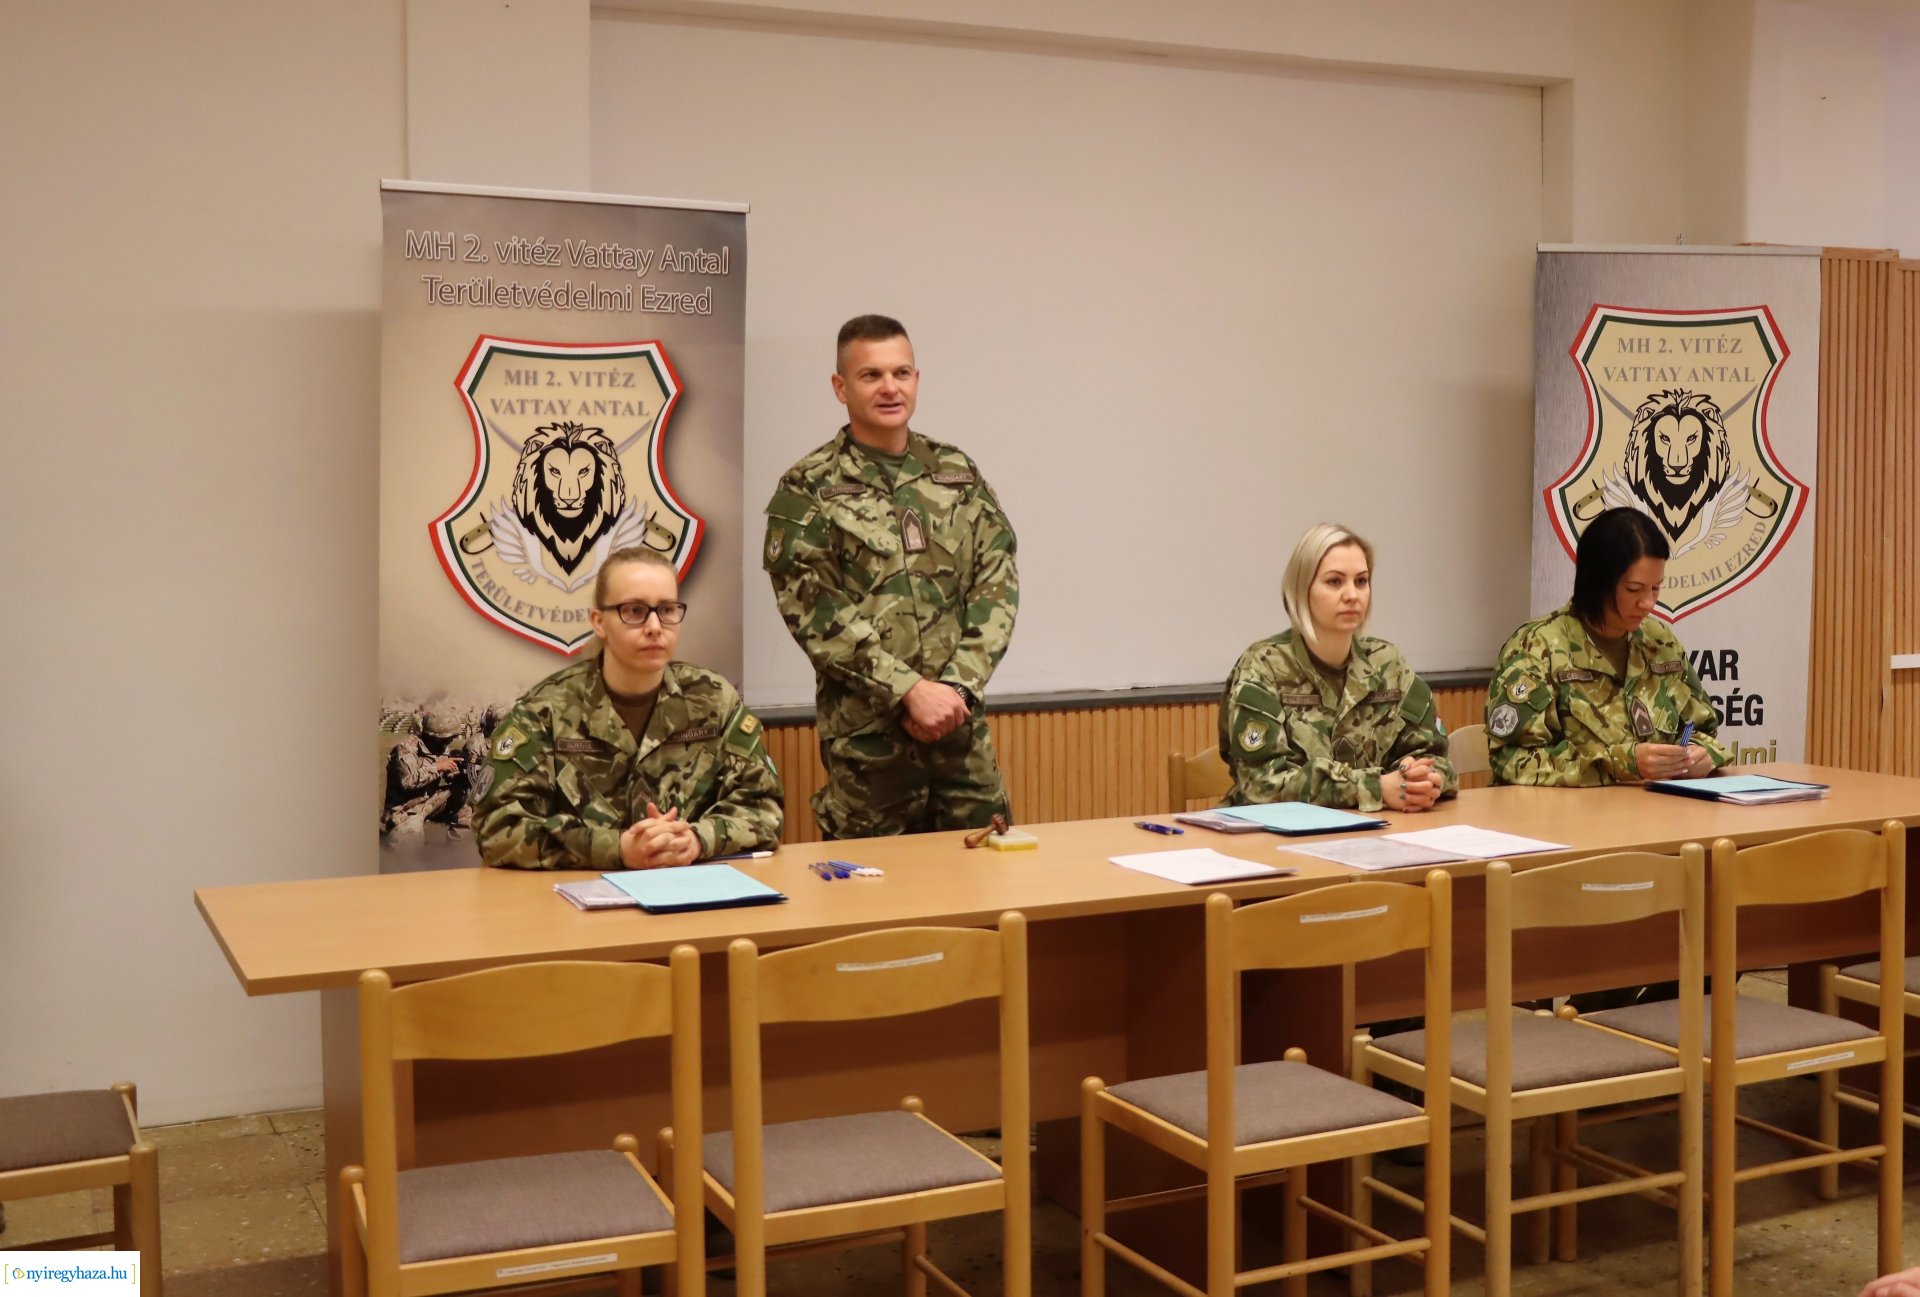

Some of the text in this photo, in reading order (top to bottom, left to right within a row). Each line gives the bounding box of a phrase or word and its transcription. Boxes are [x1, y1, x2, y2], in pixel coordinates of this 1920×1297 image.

[405, 229, 730, 277] MH 2. vitéz Vattay Antal
[421, 274, 713, 315] Területvédelmi Ezred
[1617, 333, 1743, 353] MH 2. VITÉZ
[504, 368, 636, 389] MH 2. VITÉZ
[1603, 366, 1756, 383] VATTAY ANTAL
[490, 398, 650, 417] VATTAY ANTAL
[1725, 521, 1766, 573] EZRED
